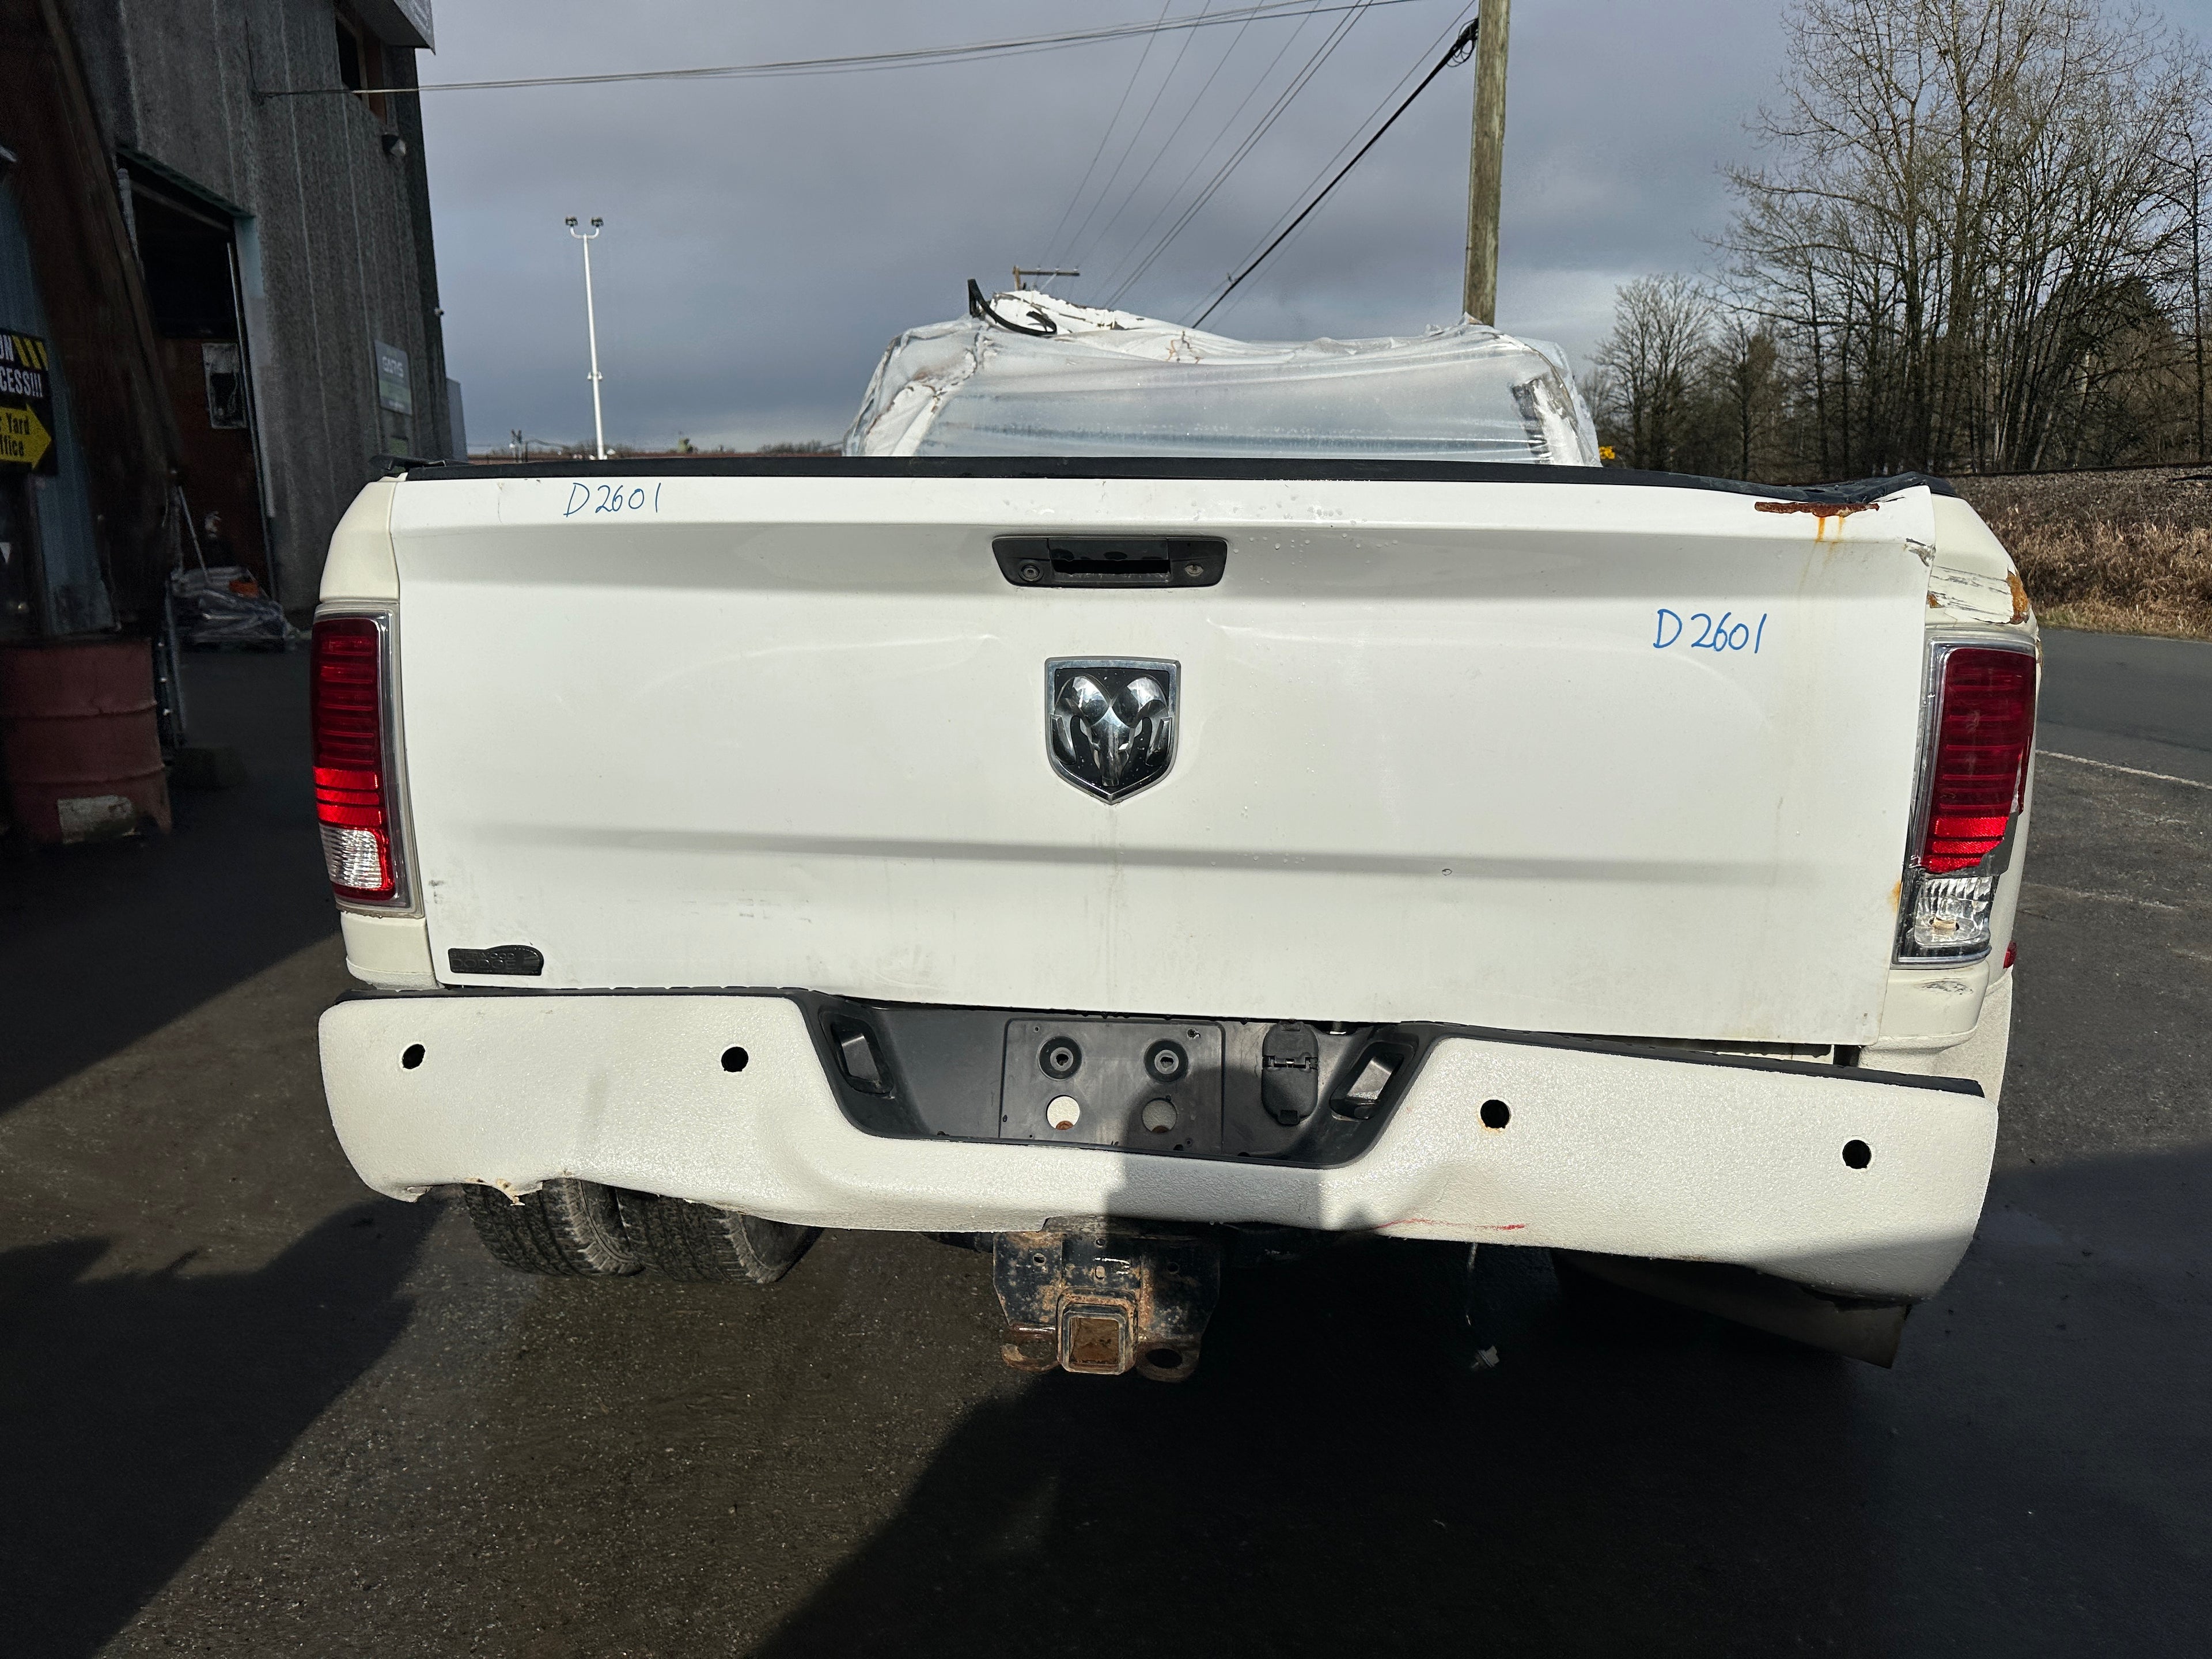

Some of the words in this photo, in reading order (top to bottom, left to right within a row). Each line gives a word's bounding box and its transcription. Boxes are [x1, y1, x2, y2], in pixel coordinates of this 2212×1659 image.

[6, 412, 30, 435] Yard
[563, 483, 662, 517] D2601
[1653, 609, 1767, 654] D2601
[449, 950, 516, 960] SHERWOOD
[451, 959, 517, 969] DODGE
